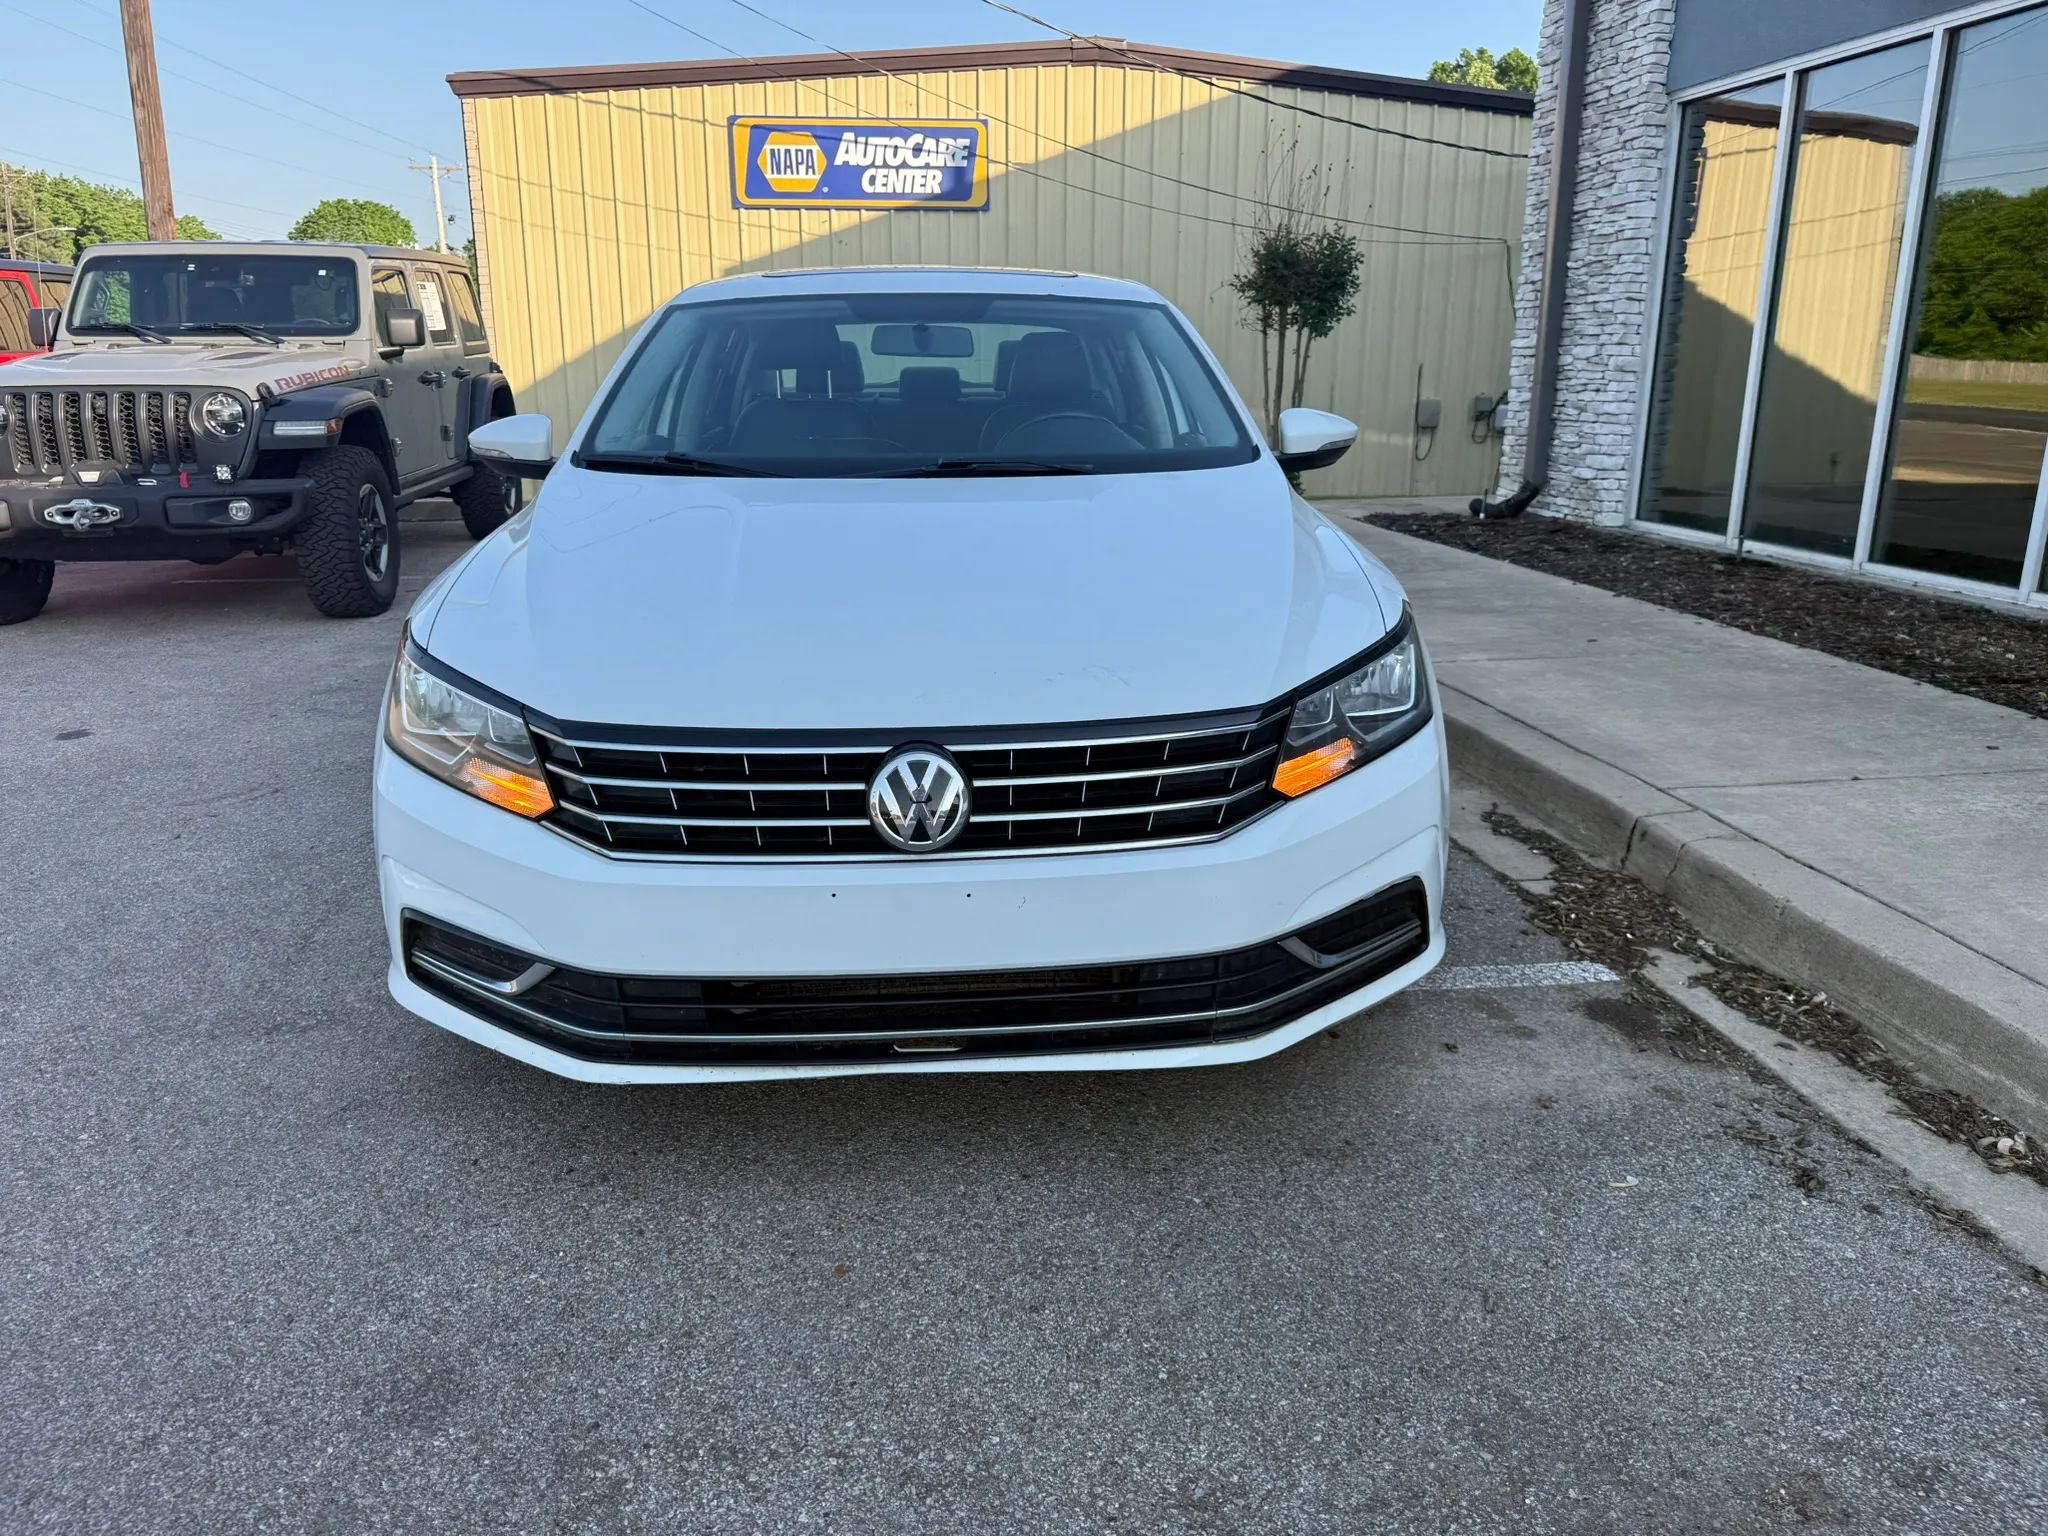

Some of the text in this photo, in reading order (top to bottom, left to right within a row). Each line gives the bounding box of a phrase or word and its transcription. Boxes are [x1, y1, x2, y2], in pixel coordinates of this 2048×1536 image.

[769, 148, 816, 176] NAPA
[861, 168, 943, 194] CENTER
[274, 364, 352, 391] RUBICON
[870, 751, 969, 852] VW
